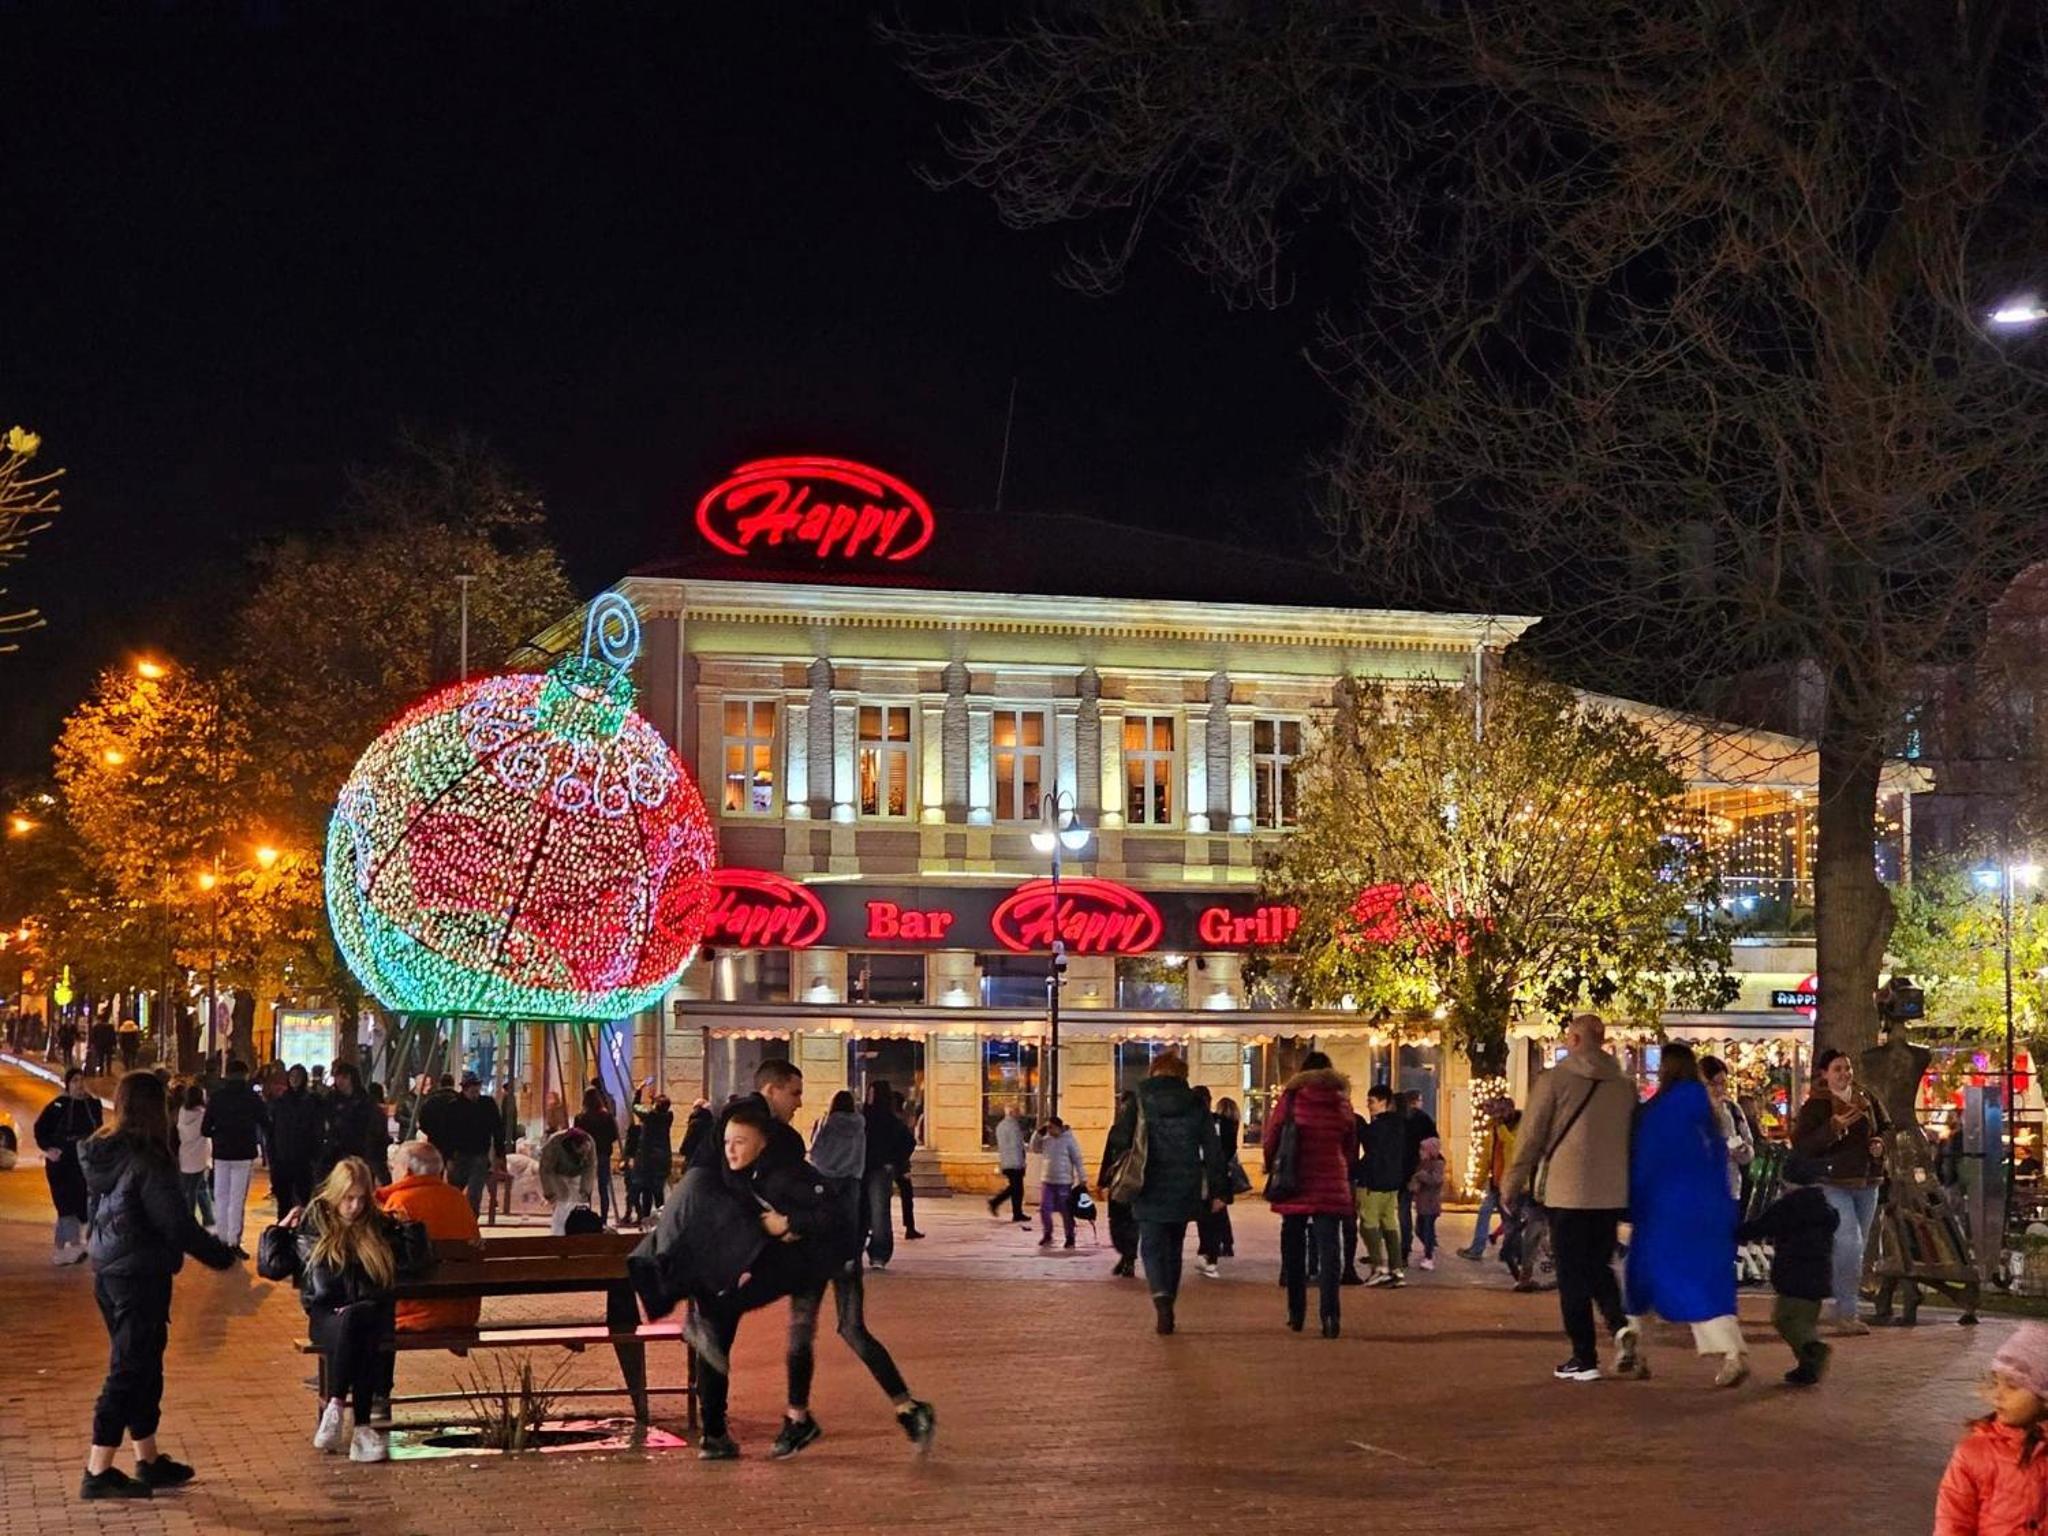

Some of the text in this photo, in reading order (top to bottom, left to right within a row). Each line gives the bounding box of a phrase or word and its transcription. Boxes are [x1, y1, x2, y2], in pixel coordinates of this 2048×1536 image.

[726, 479, 911, 557] Happy
[865, 901, 954, 940] Bar
[1013, 895, 1146, 951] Happy
